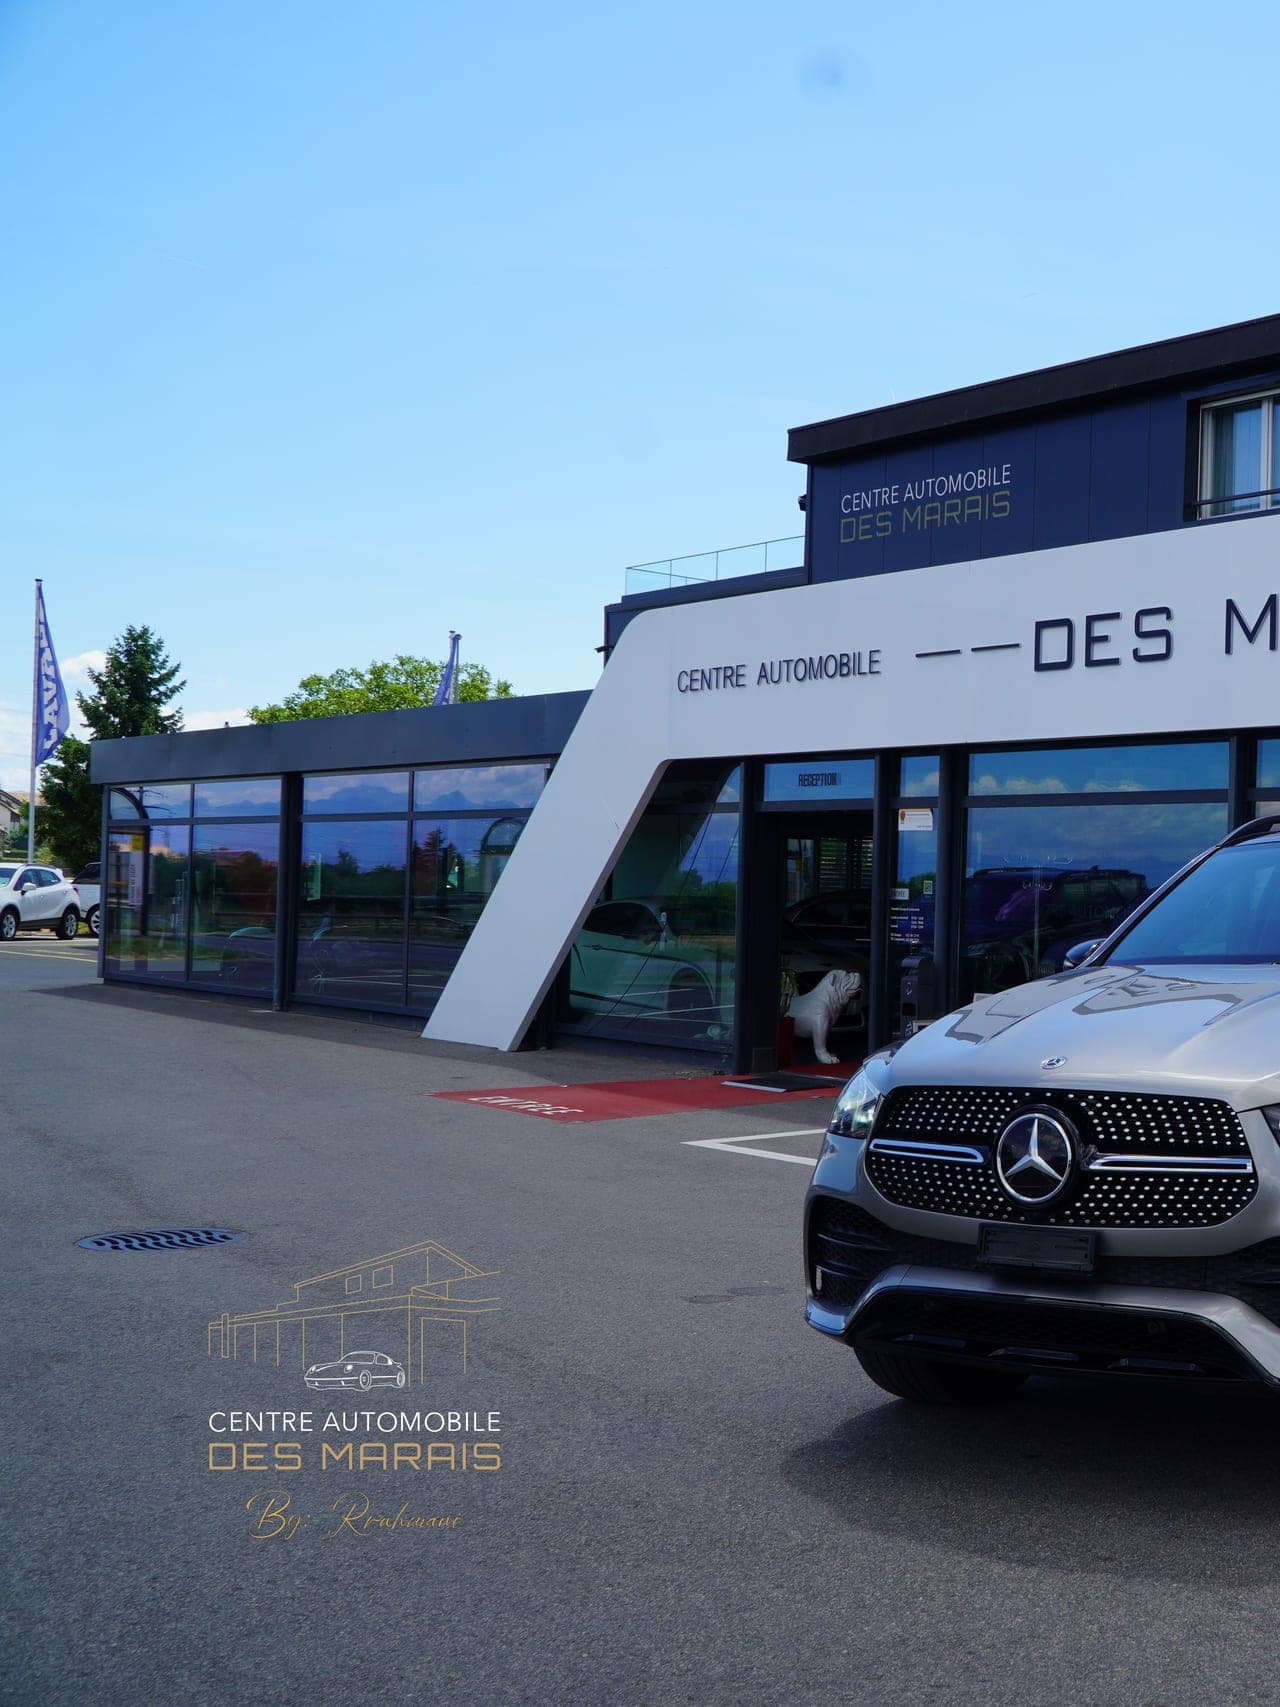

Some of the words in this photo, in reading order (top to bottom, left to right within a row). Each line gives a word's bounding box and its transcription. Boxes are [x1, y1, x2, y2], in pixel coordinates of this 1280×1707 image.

[841, 485, 899, 513] CENTRE
[904, 464, 1011, 502] AUTOMOBILE
[840, 511, 892, 543] DES
[902, 490, 1010, 533] MARAIS
[1034, 606, 1173, 672] DES
[677, 664, 747, 693] CENTRE
[757, 649, 882, 686] AUTOMOBILE
